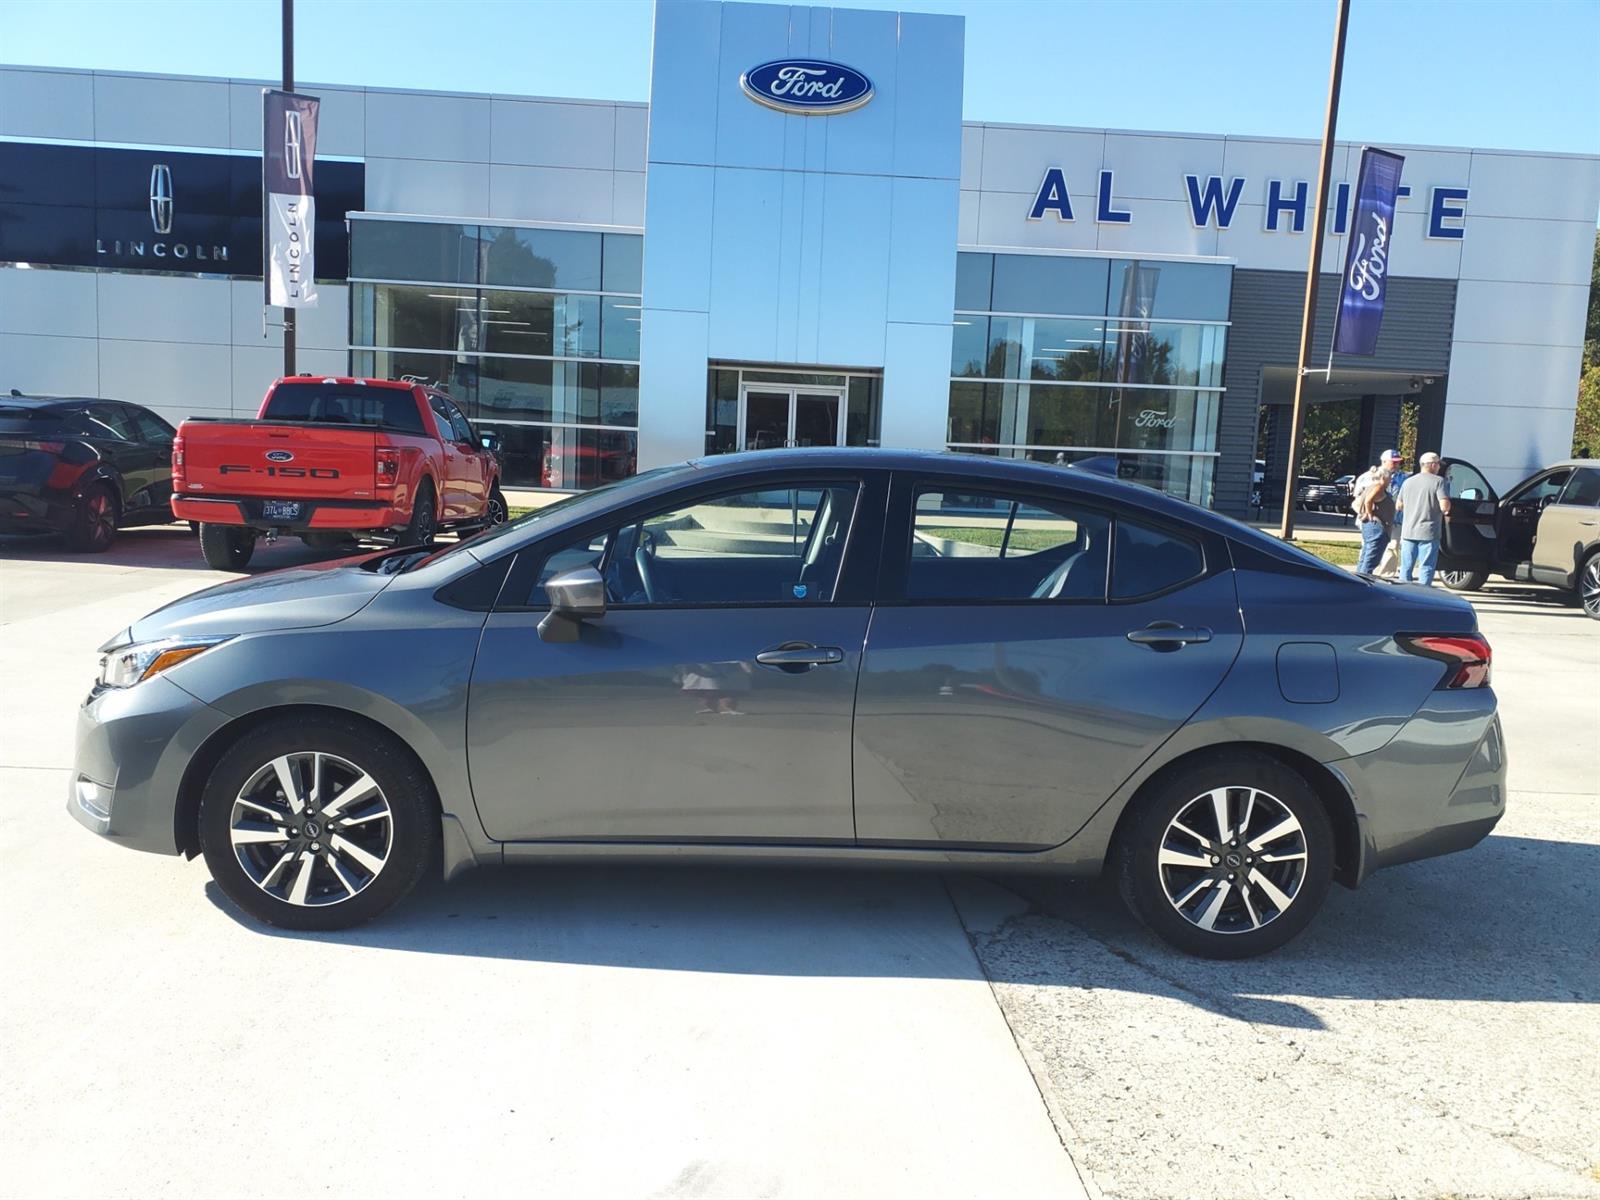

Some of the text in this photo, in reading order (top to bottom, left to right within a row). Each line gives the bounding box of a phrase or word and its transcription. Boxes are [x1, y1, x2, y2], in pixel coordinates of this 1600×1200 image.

[770, 66, 846, 98] Ford
[1027, 166, 1470, 241] AL WHIE
[96, 239, 230, 261] LINCOLN
[287, 202, 301, 299] LINCOLN
[1349, 210, 1388, 301] Ford
[1134, 409, 1178, 429] Ford
[218, 464, 340, 479] F-150
